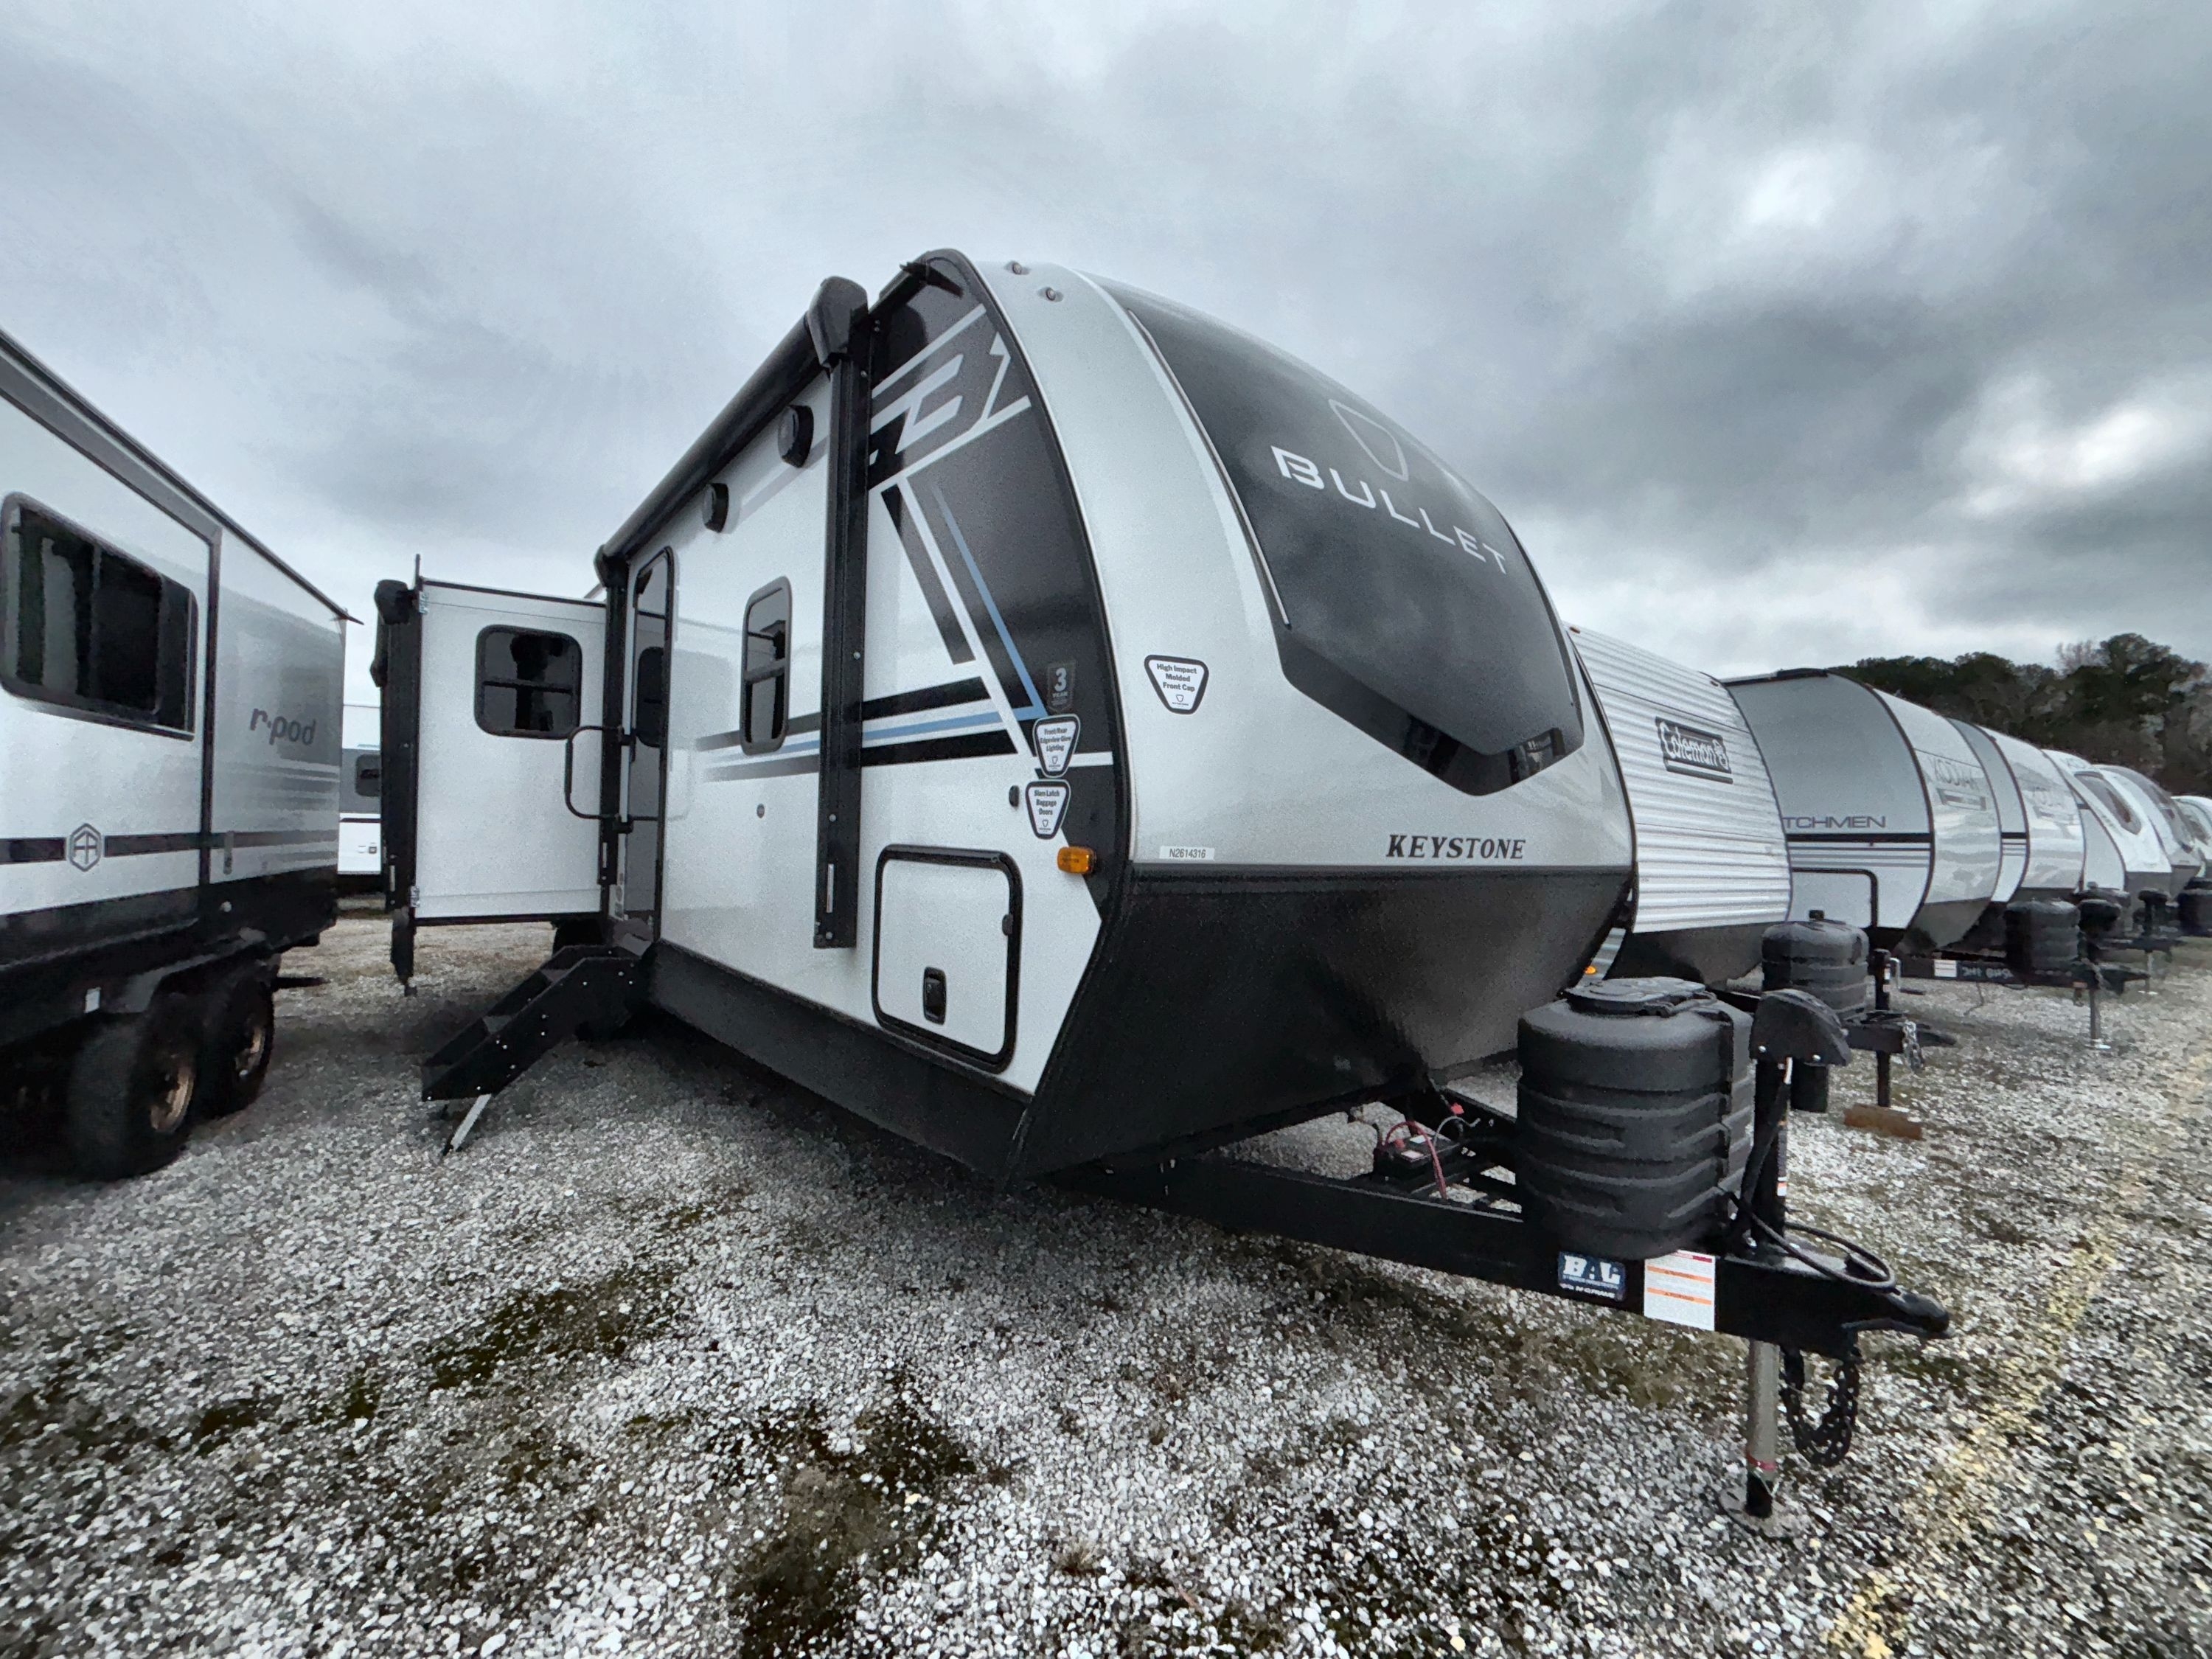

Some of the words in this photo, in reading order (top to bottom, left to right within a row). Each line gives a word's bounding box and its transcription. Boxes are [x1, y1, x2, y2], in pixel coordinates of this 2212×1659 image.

[1270, 445, 1506, 575] BULLET
[1156, 664, 1173, 672] High
[1174, 665, 1197, 674] Impact
[1054, 667, 1067, 692] 3
[1166, 673, 1191, 682] Molded
[1163, 682, 1181, 690] Front
[1182, 684, 1195, 692] Cap
[1659, 721, 1719, 768] Coleman
[1036, 799, 1057, 807] Baggage
[1781, 815, 1886, 828] TCHMEN
[1385, 834, 1526, 860] KEYSTONE
[1169, 848, 1206, 859] N2614316
